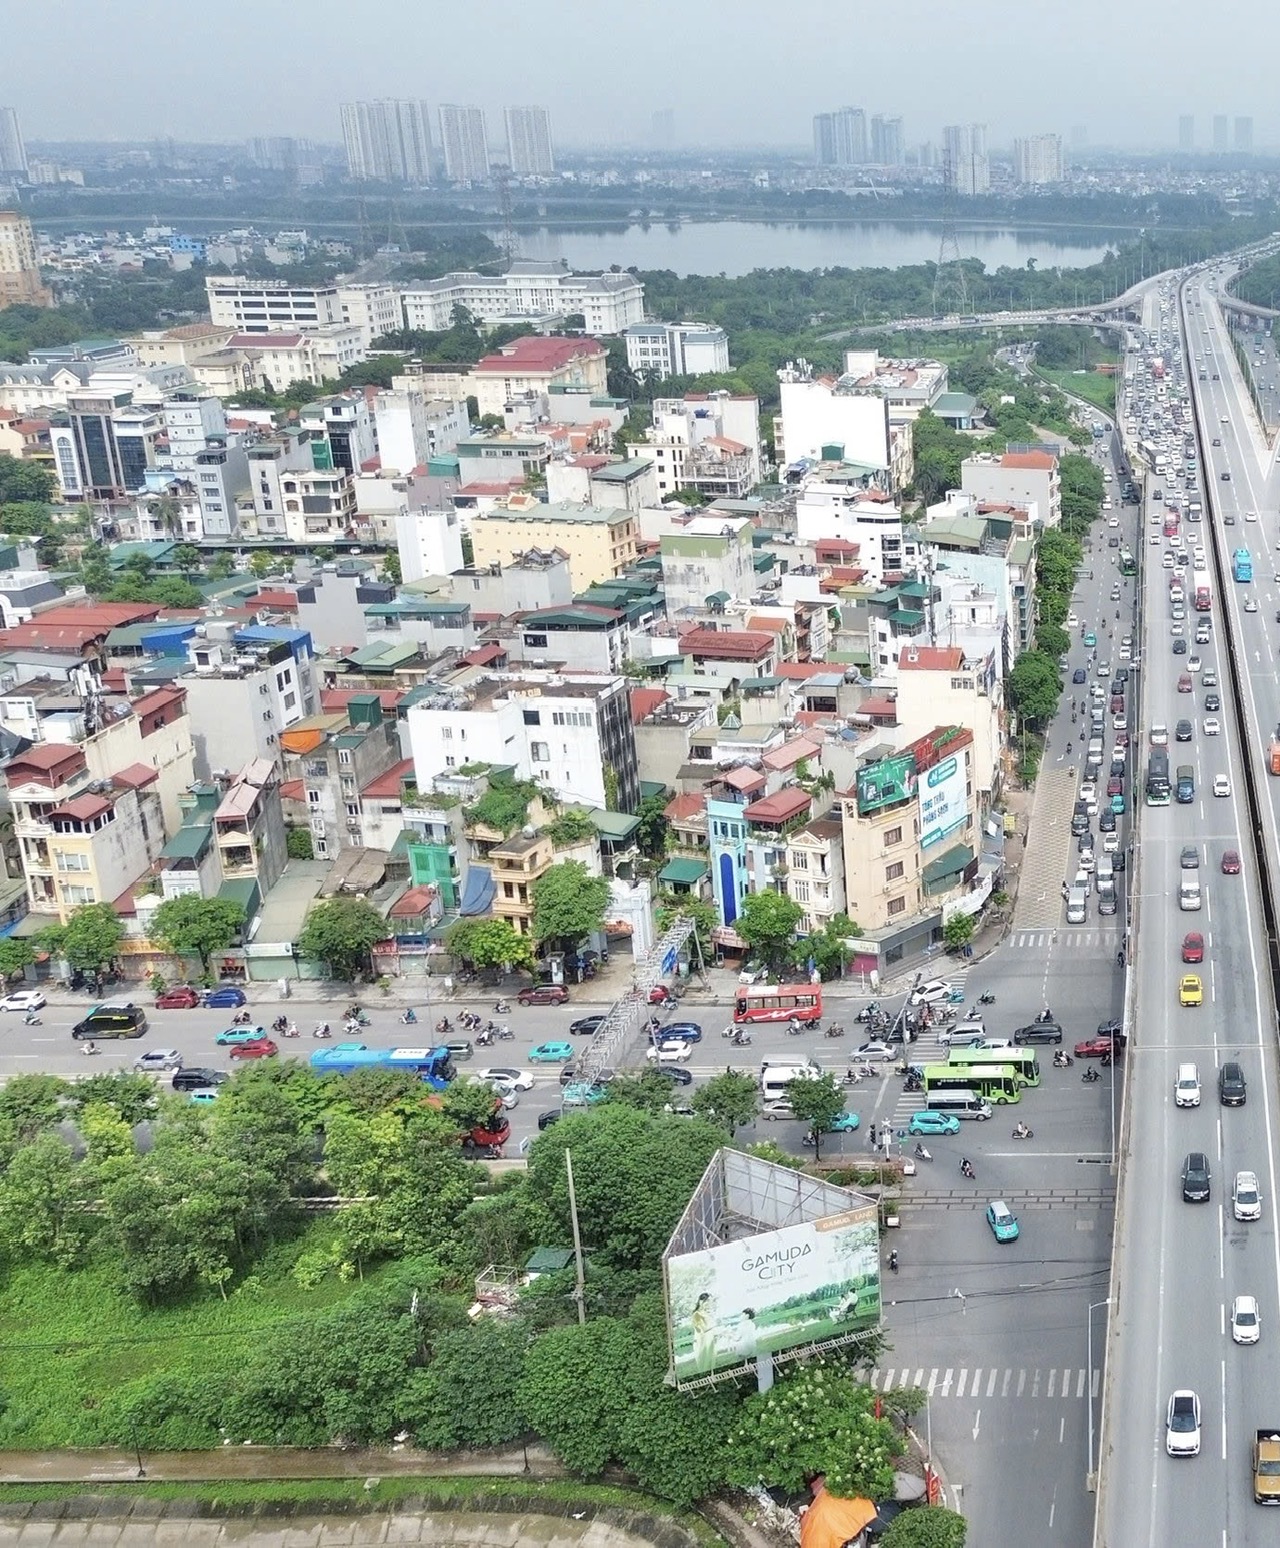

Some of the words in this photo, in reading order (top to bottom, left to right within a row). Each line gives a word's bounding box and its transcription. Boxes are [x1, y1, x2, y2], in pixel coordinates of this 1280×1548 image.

[823, 1216, 851, 1229] GAMUD
[741, 1243, 812, 1271] GAMUDA
[758, 1262, 796, 1280] CITY
